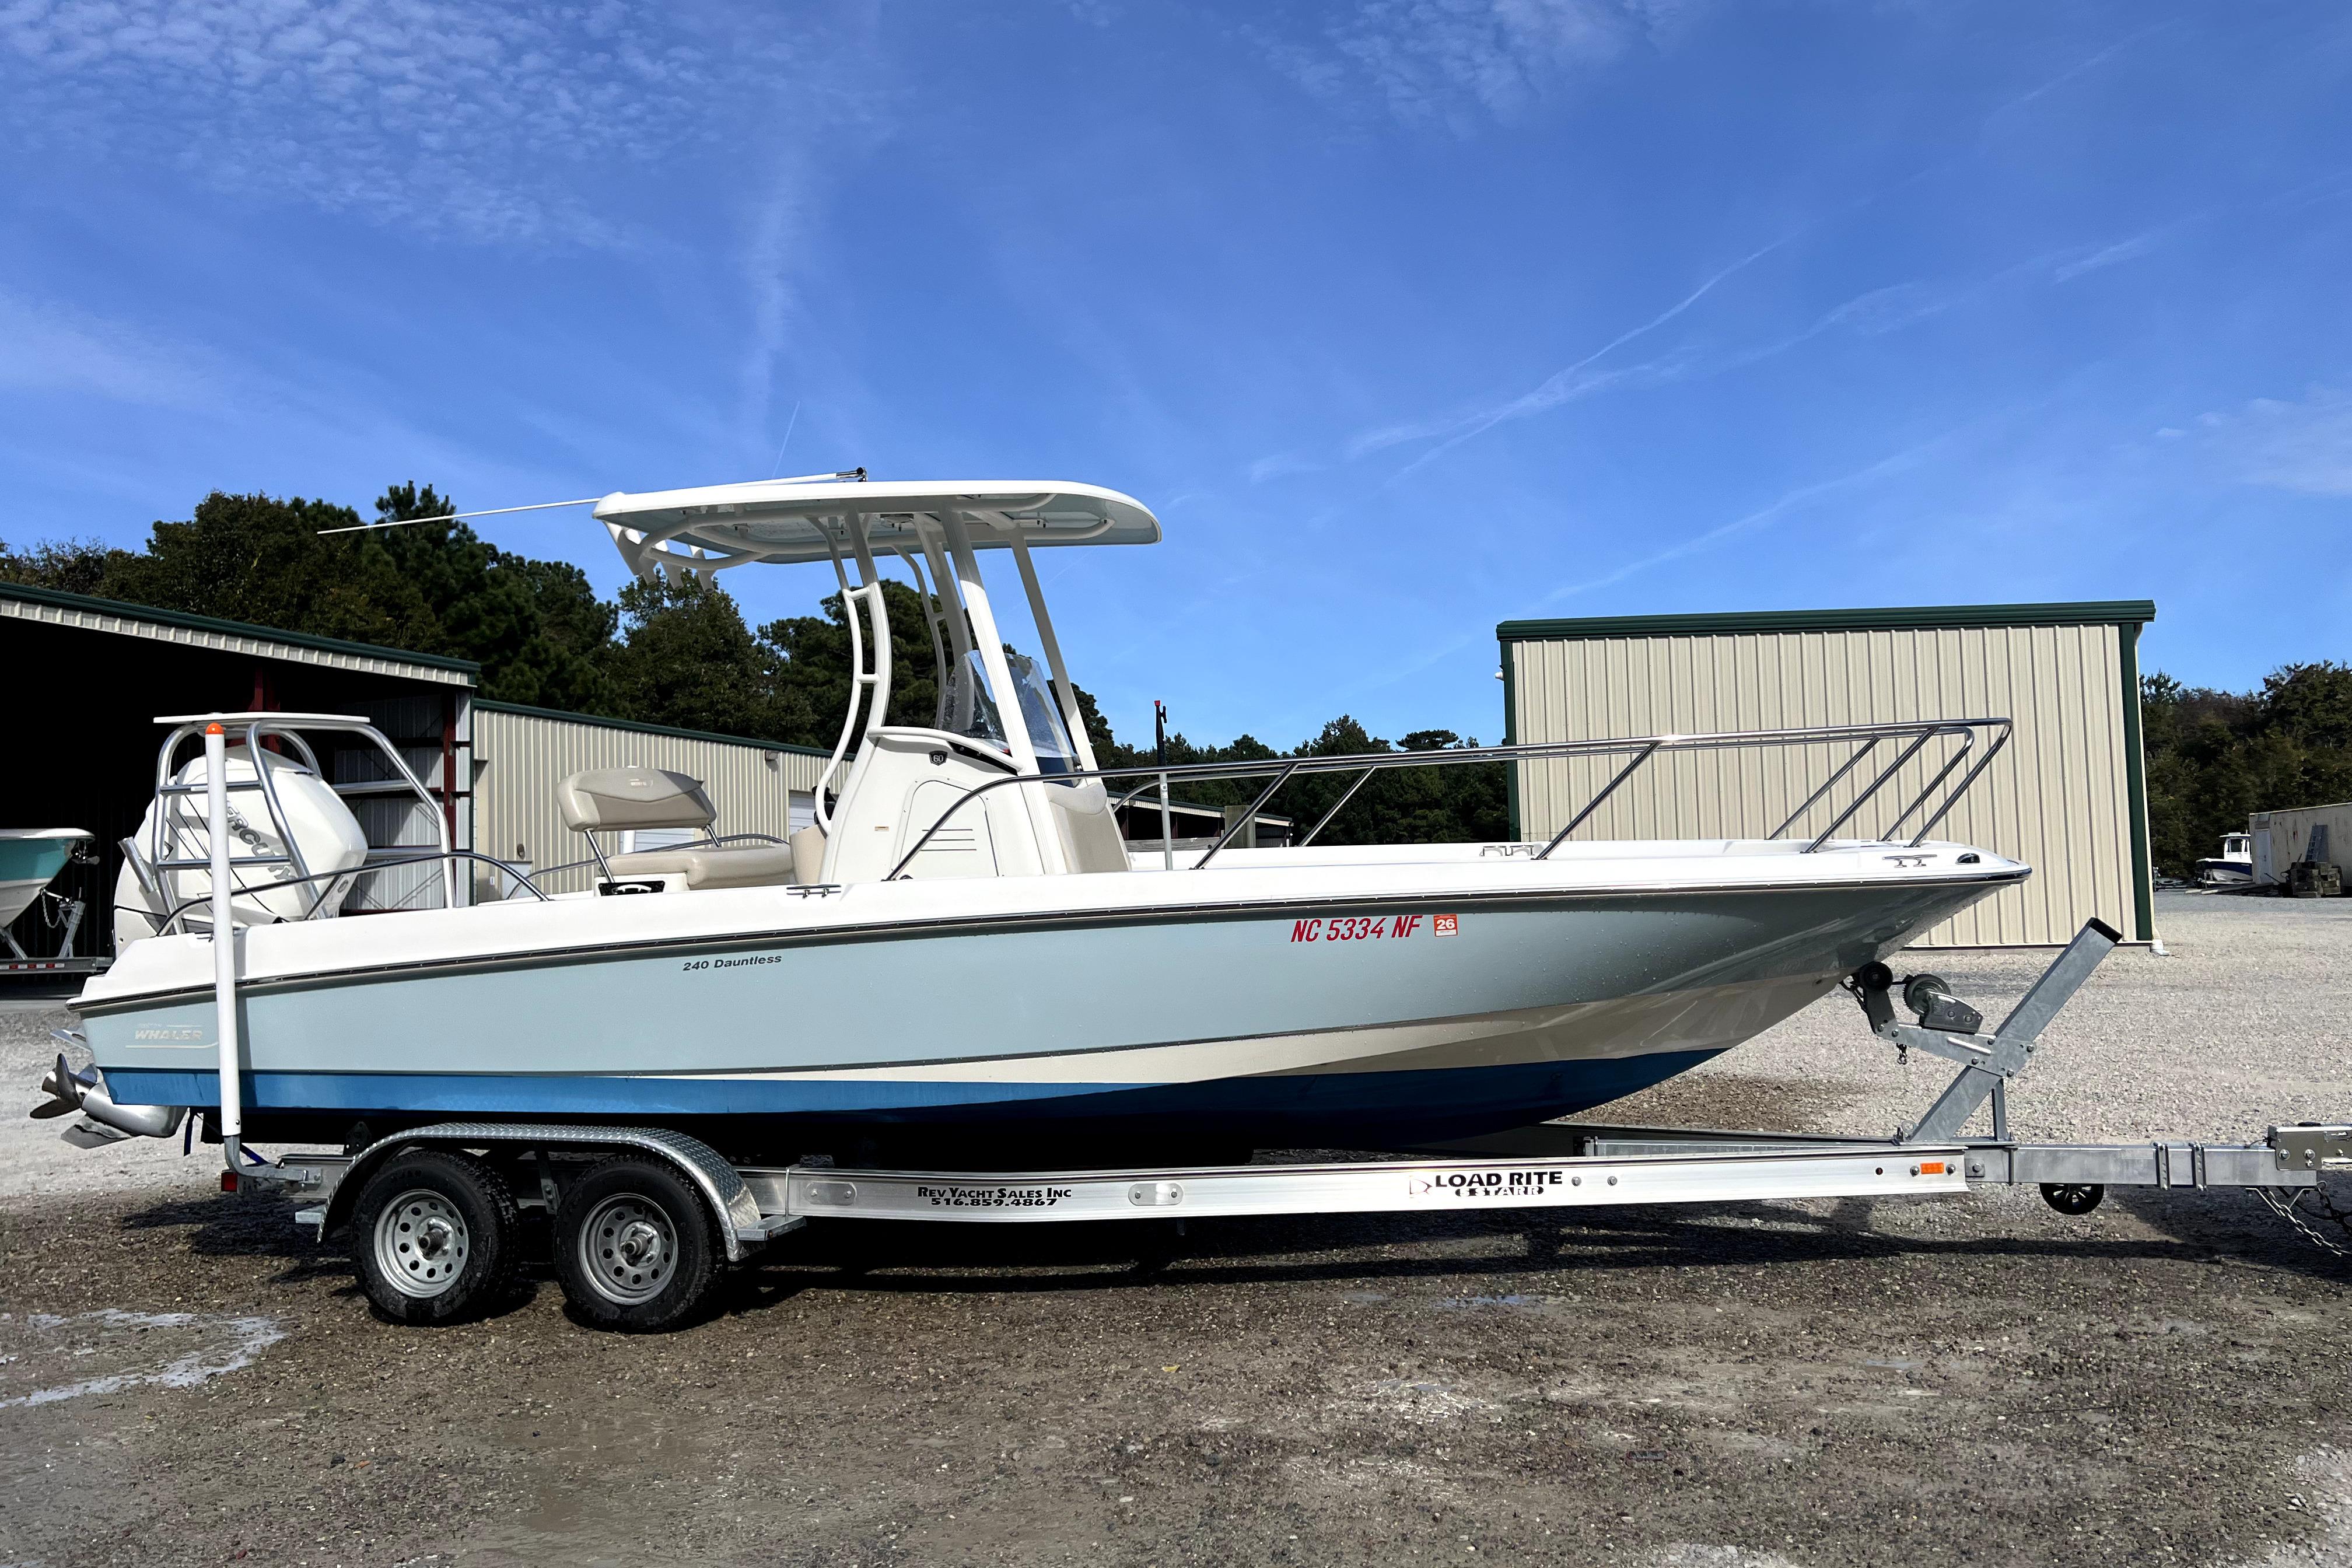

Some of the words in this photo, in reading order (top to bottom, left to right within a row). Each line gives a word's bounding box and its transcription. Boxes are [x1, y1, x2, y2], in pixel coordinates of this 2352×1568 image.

[1290, 919, 1322, 943] NC
[1326, 917, 1387, 941] 5334
[1391, 915, 1423, 938] NF
[1437, 918, 1455, 930] 26
[683, 961, 709, 971] 240
[714, 956, 782, 968] Dauntless
[135, 1029, 203, 1040] WHALER
[1436, 1172, 1502, 1188] LOAD
[1509, 1171, 1563, 1186] RITE
[931, 1198, 1058, 1206] 516.859.4867
